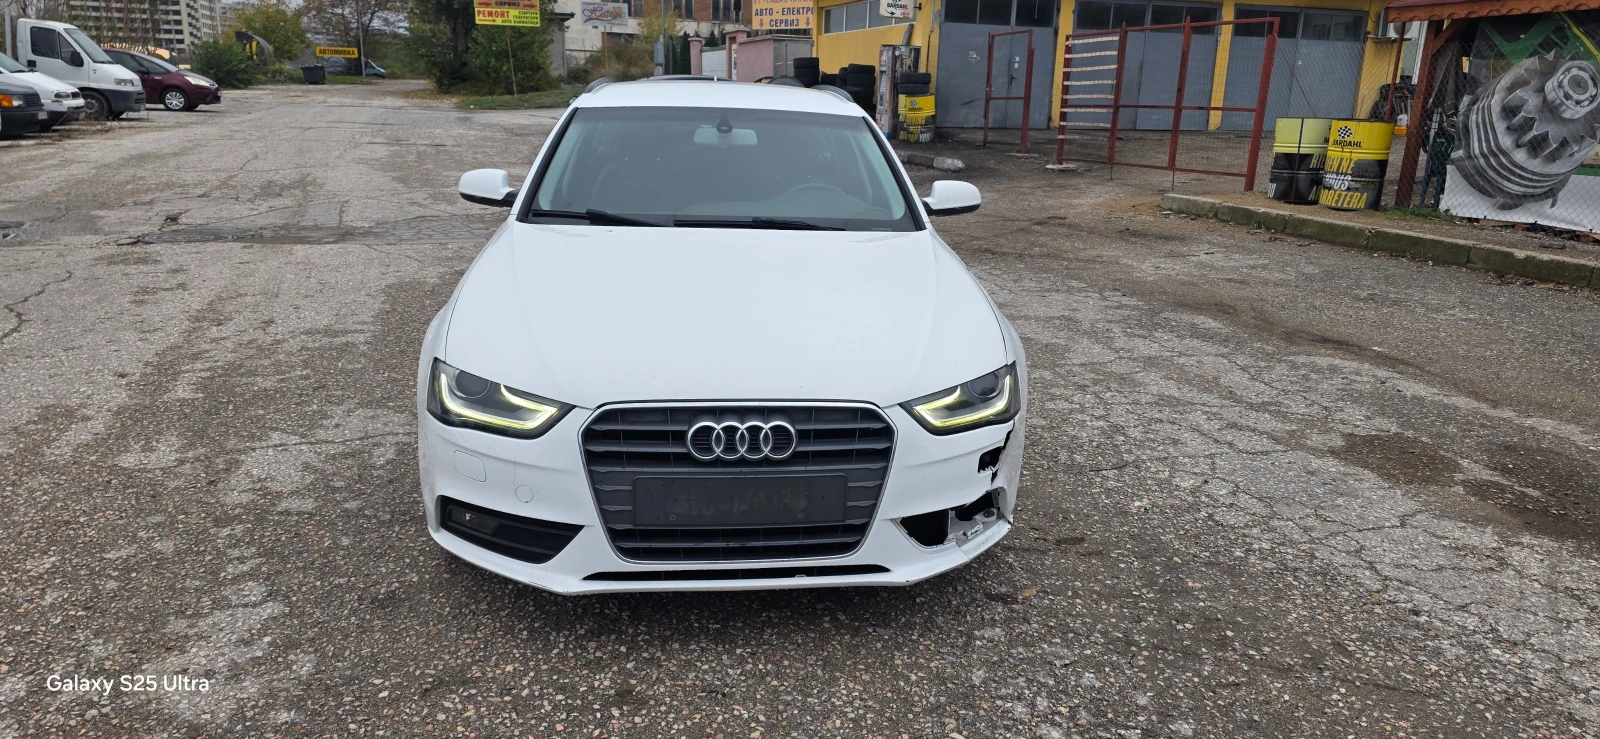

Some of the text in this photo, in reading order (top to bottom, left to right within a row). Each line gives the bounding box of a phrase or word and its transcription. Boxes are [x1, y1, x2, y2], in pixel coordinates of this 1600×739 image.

[476, 10, 510, 18] РЕМОНТ
[754, 8, 773, 16] АВТО
[769, 19, 799, 27] СЕРВИЗ
[319, 48, 355, 56] АВТОМИВКА
[1332, 139, 1363, 148] BARDAHL
